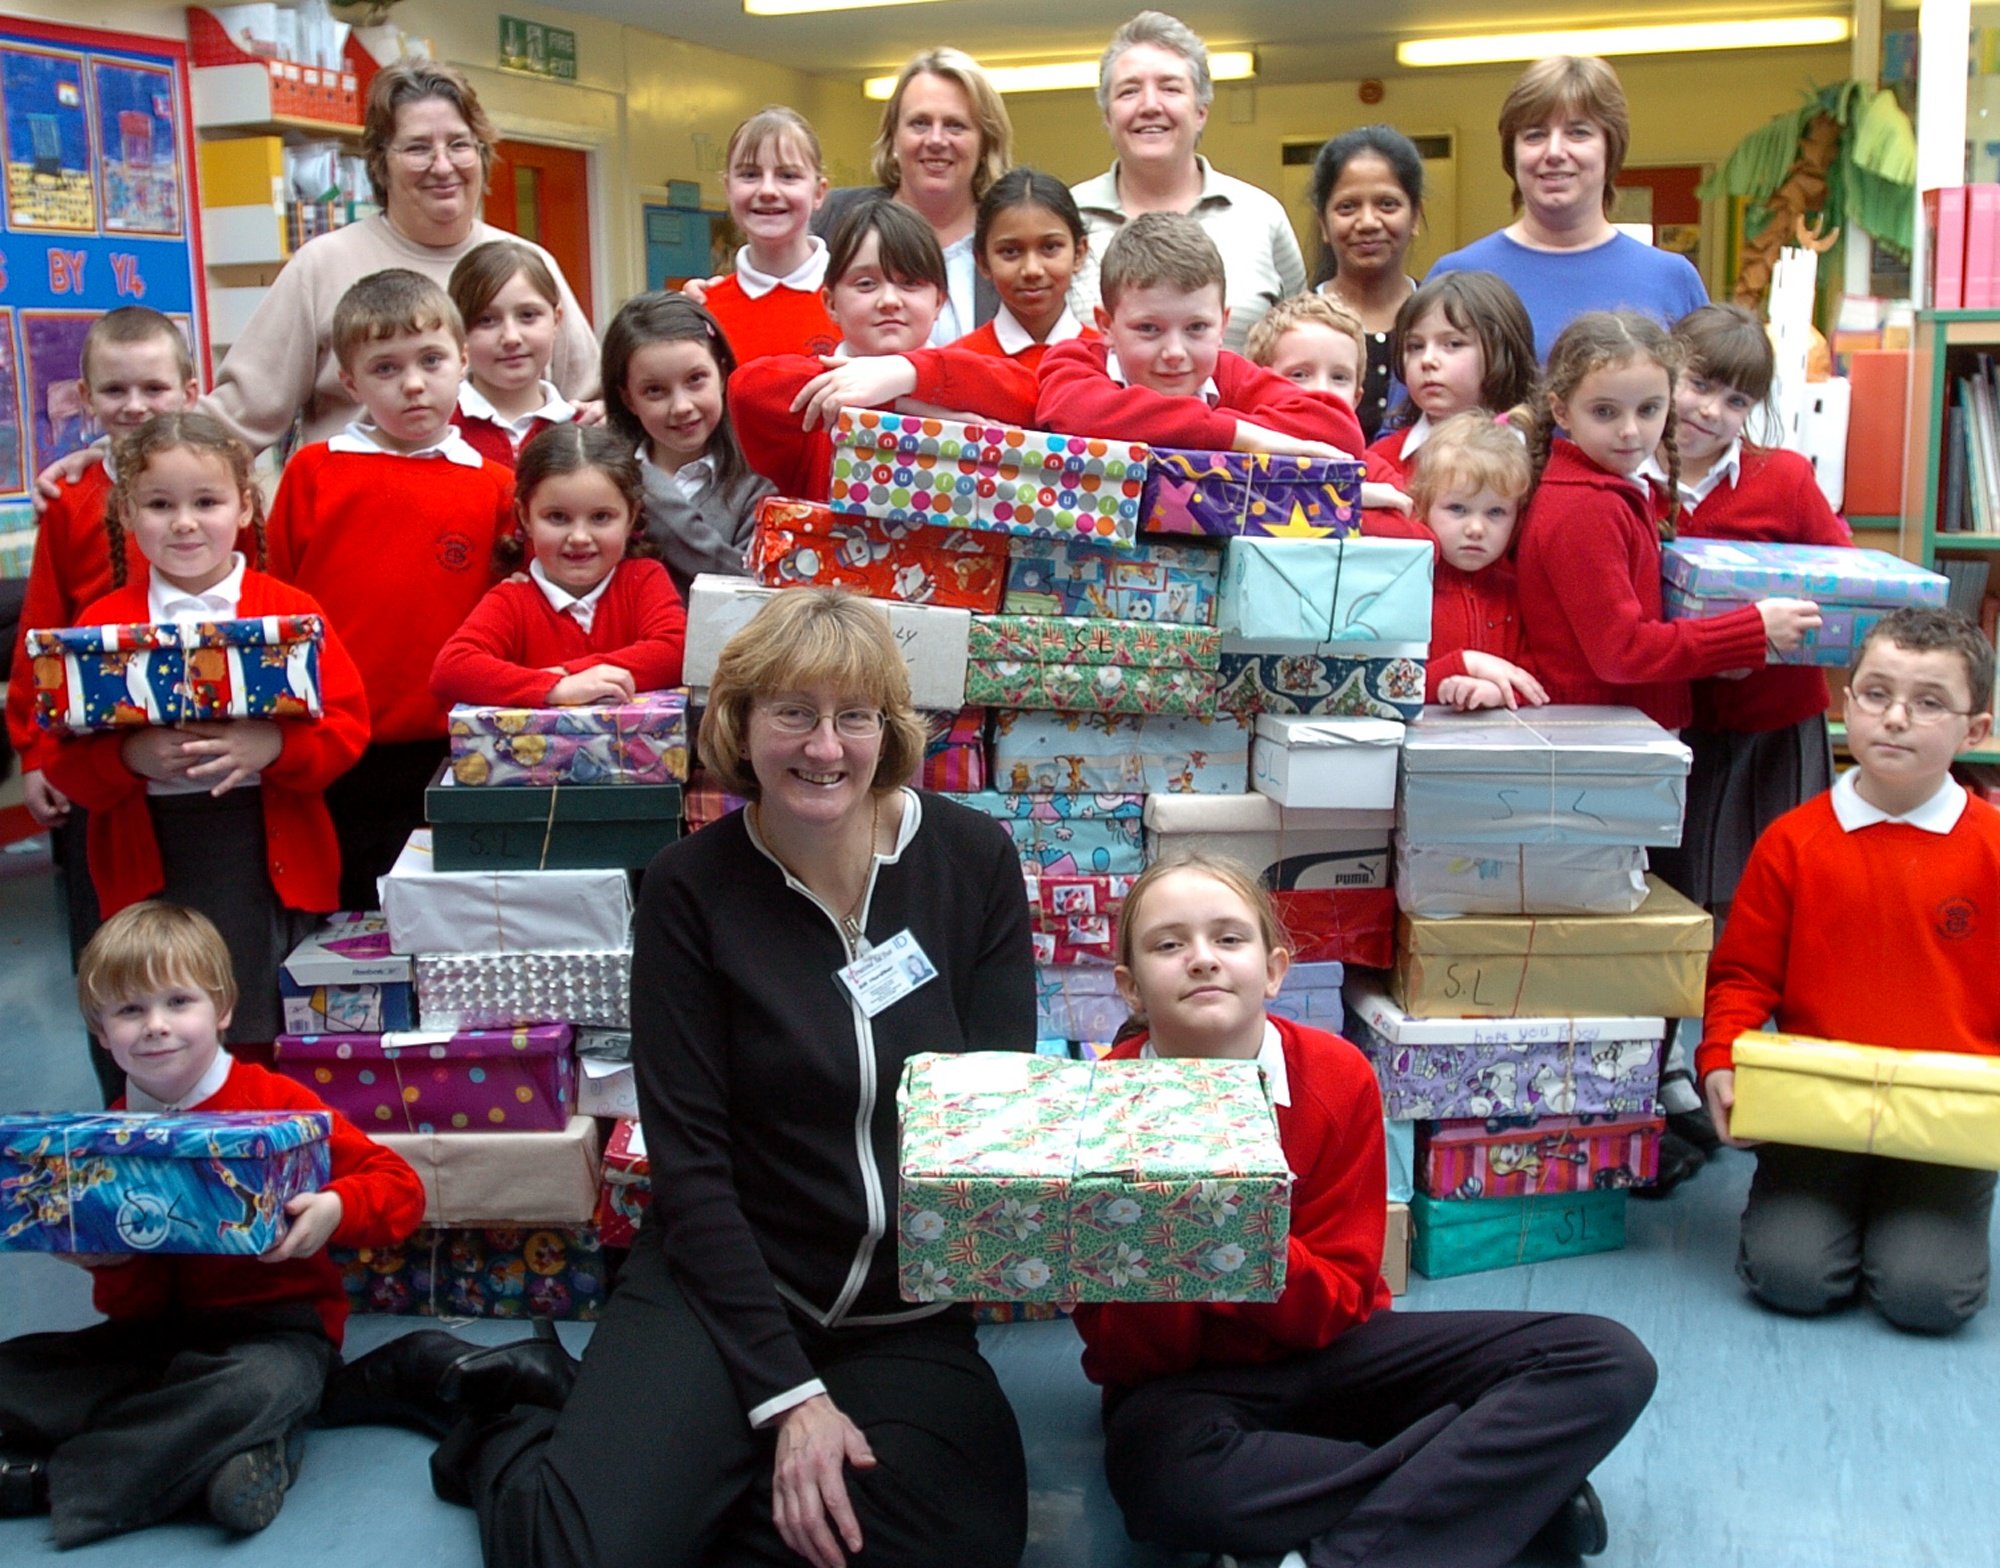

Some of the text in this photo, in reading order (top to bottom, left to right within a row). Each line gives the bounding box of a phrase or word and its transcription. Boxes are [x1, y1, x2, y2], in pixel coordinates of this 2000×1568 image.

[47, 248, 87, 295] BY
[109, 252, 147, 299] Y4
[858, 466, 909, 482] you
[941, 476, 990, 493] for
[1023, 489, 1072, 507] you
[1335, 873, 1370, 885] PUMA
[1519, 1025, 1549, 1042] you
